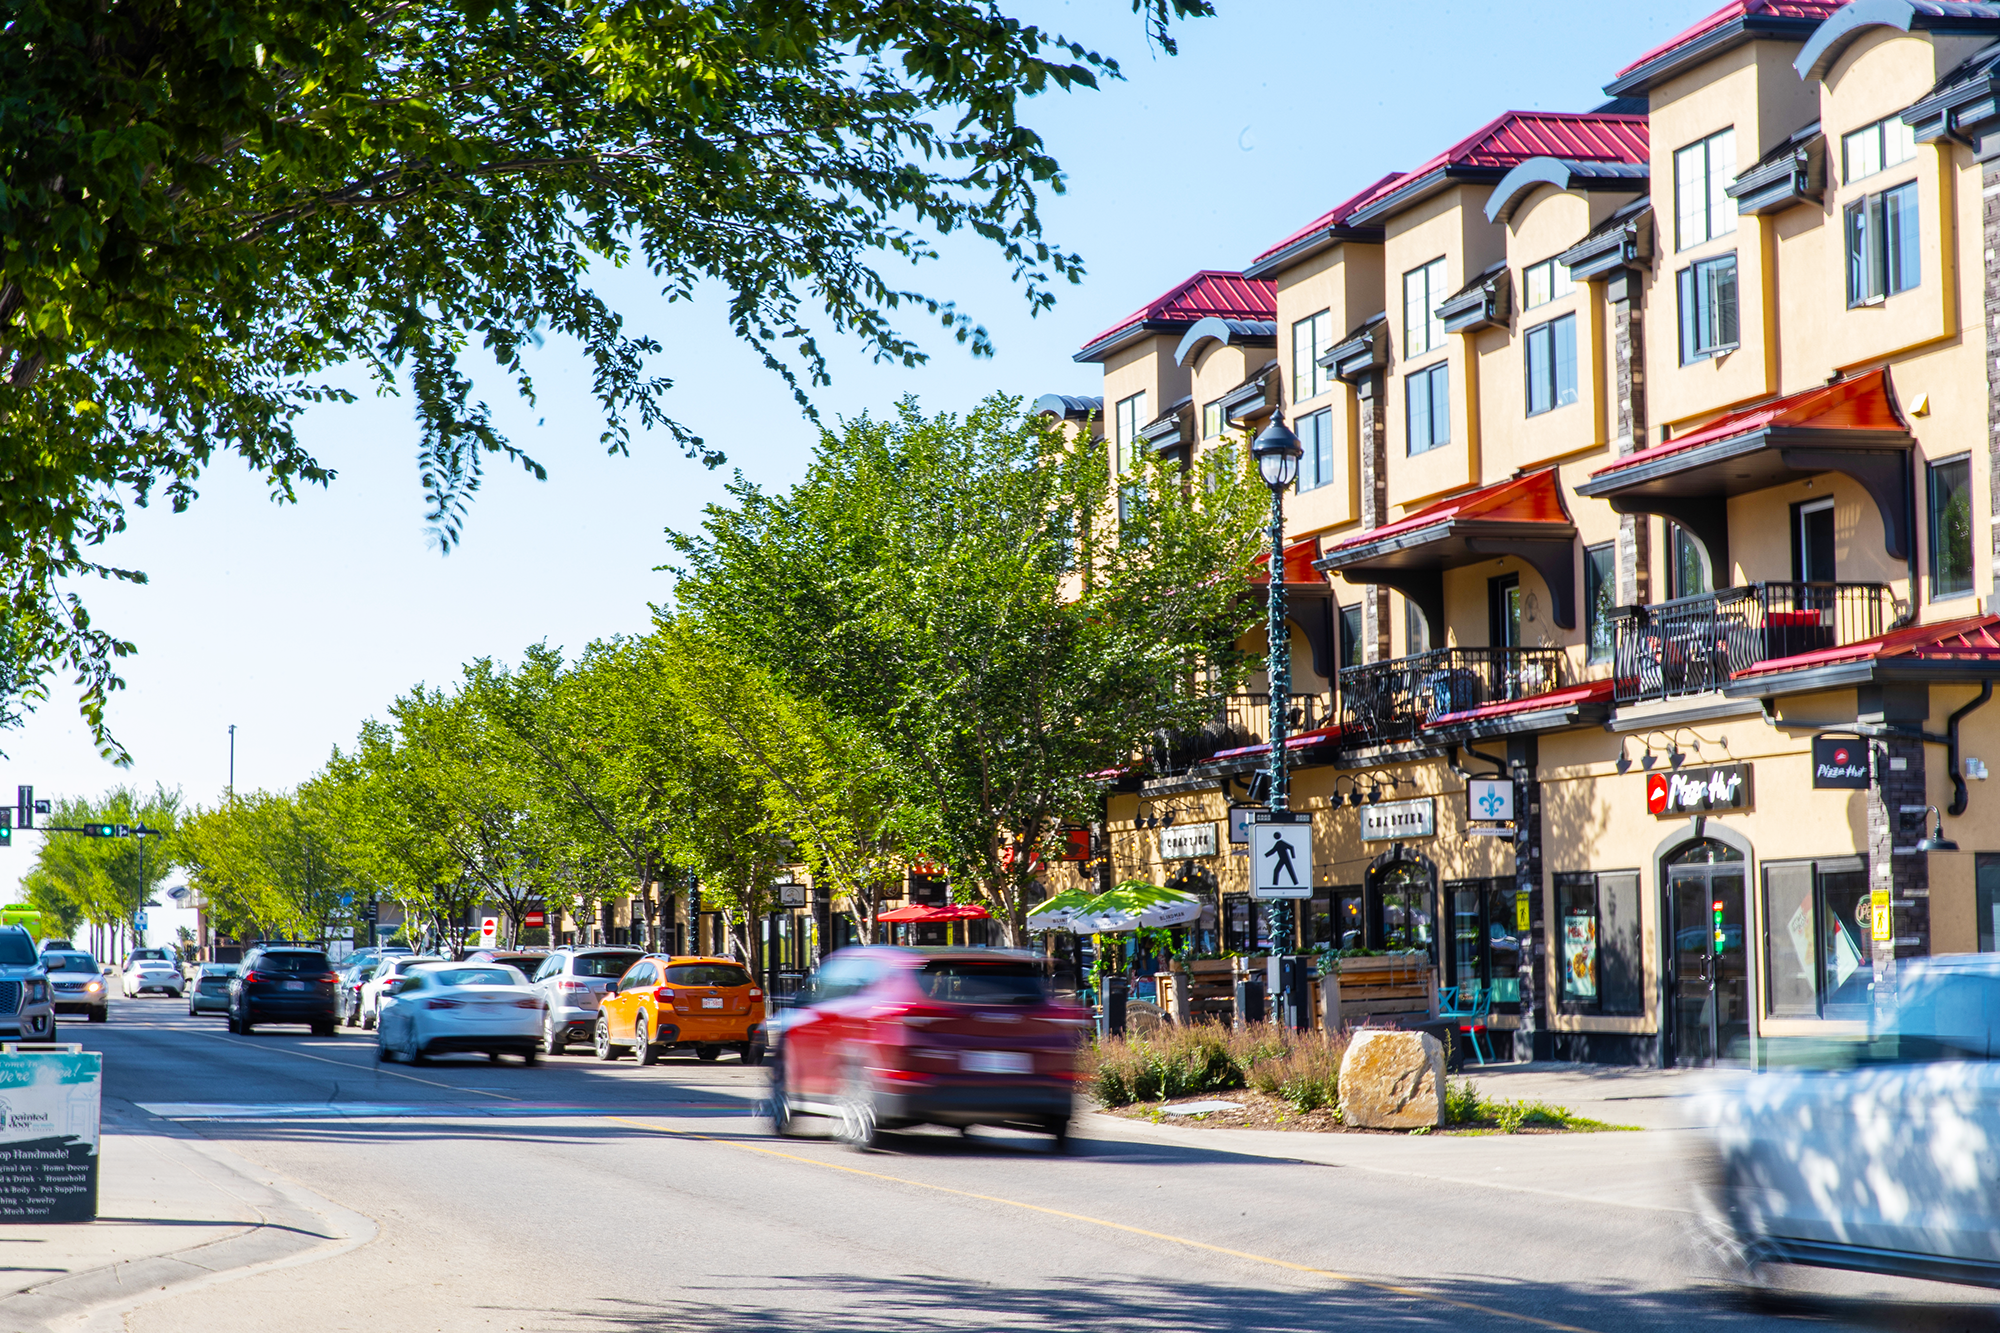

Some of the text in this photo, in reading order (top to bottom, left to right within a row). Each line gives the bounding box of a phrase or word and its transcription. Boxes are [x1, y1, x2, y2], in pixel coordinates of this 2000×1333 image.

[1816, 763, 1867, 778] Pizza Hut
[1667, 770, 1742, 809] Pizza Hut
[1368, 812, 1424, 828] CHARTIER
[1167, 834, 1208, 847] CHARTIER
[1159, 911, 1185, 922] BLINDMAN
[1857, 902, 1872, 921] OPE
[10, 1112, 48, 1122] painted
[8, 1121, 32, 1129] door
[13, 1148, 70, 1160] Handmade!
[20, 1164, 32, 1172] Art
[42, 1164, 65, 1172] Home
[66, 1164, 90, 1172] Decor
[12, 1174, 35, 1183] Drink
[45, 1173, 87, 1183] Household
[11, 1185, 31, 1195] Body
[40, 1185, 53, 1194] Pet
[54, 1184, 88, 1195] Supplies
[26, 1195, 57, 1206] Jewelry
[3, 1206, 50, 1216] Much More!
